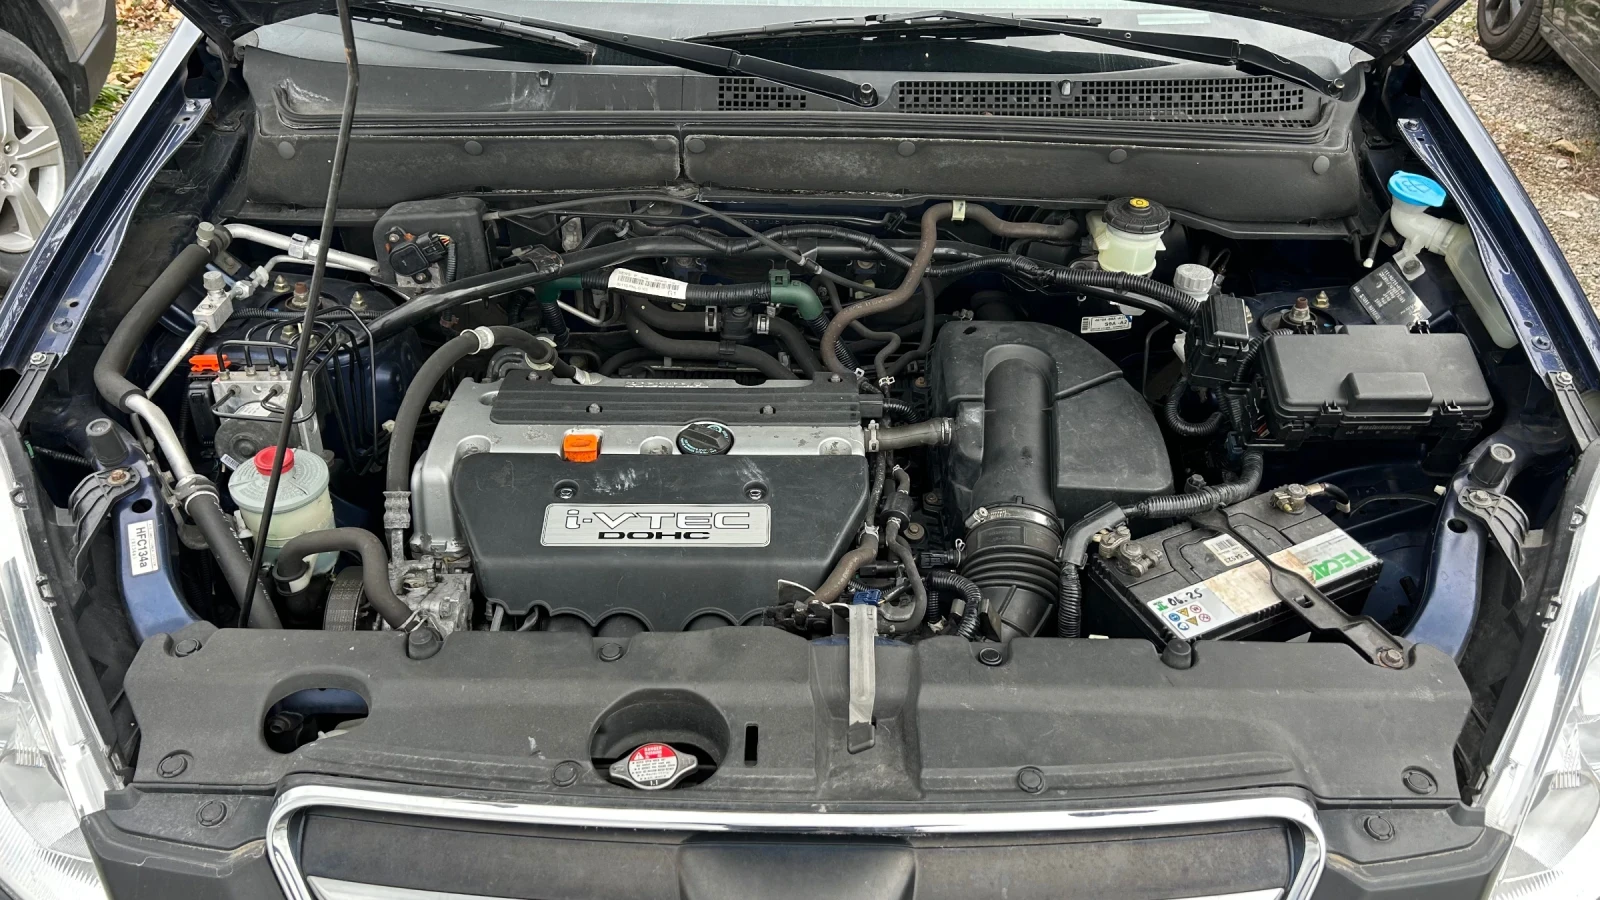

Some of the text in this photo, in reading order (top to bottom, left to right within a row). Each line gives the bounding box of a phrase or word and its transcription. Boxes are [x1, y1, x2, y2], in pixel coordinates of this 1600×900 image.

[564, 509, 750, 530] i-VTEC
[597, 531, 711, 540] DOHC
[136, 527, 148, 568] HFC134a
